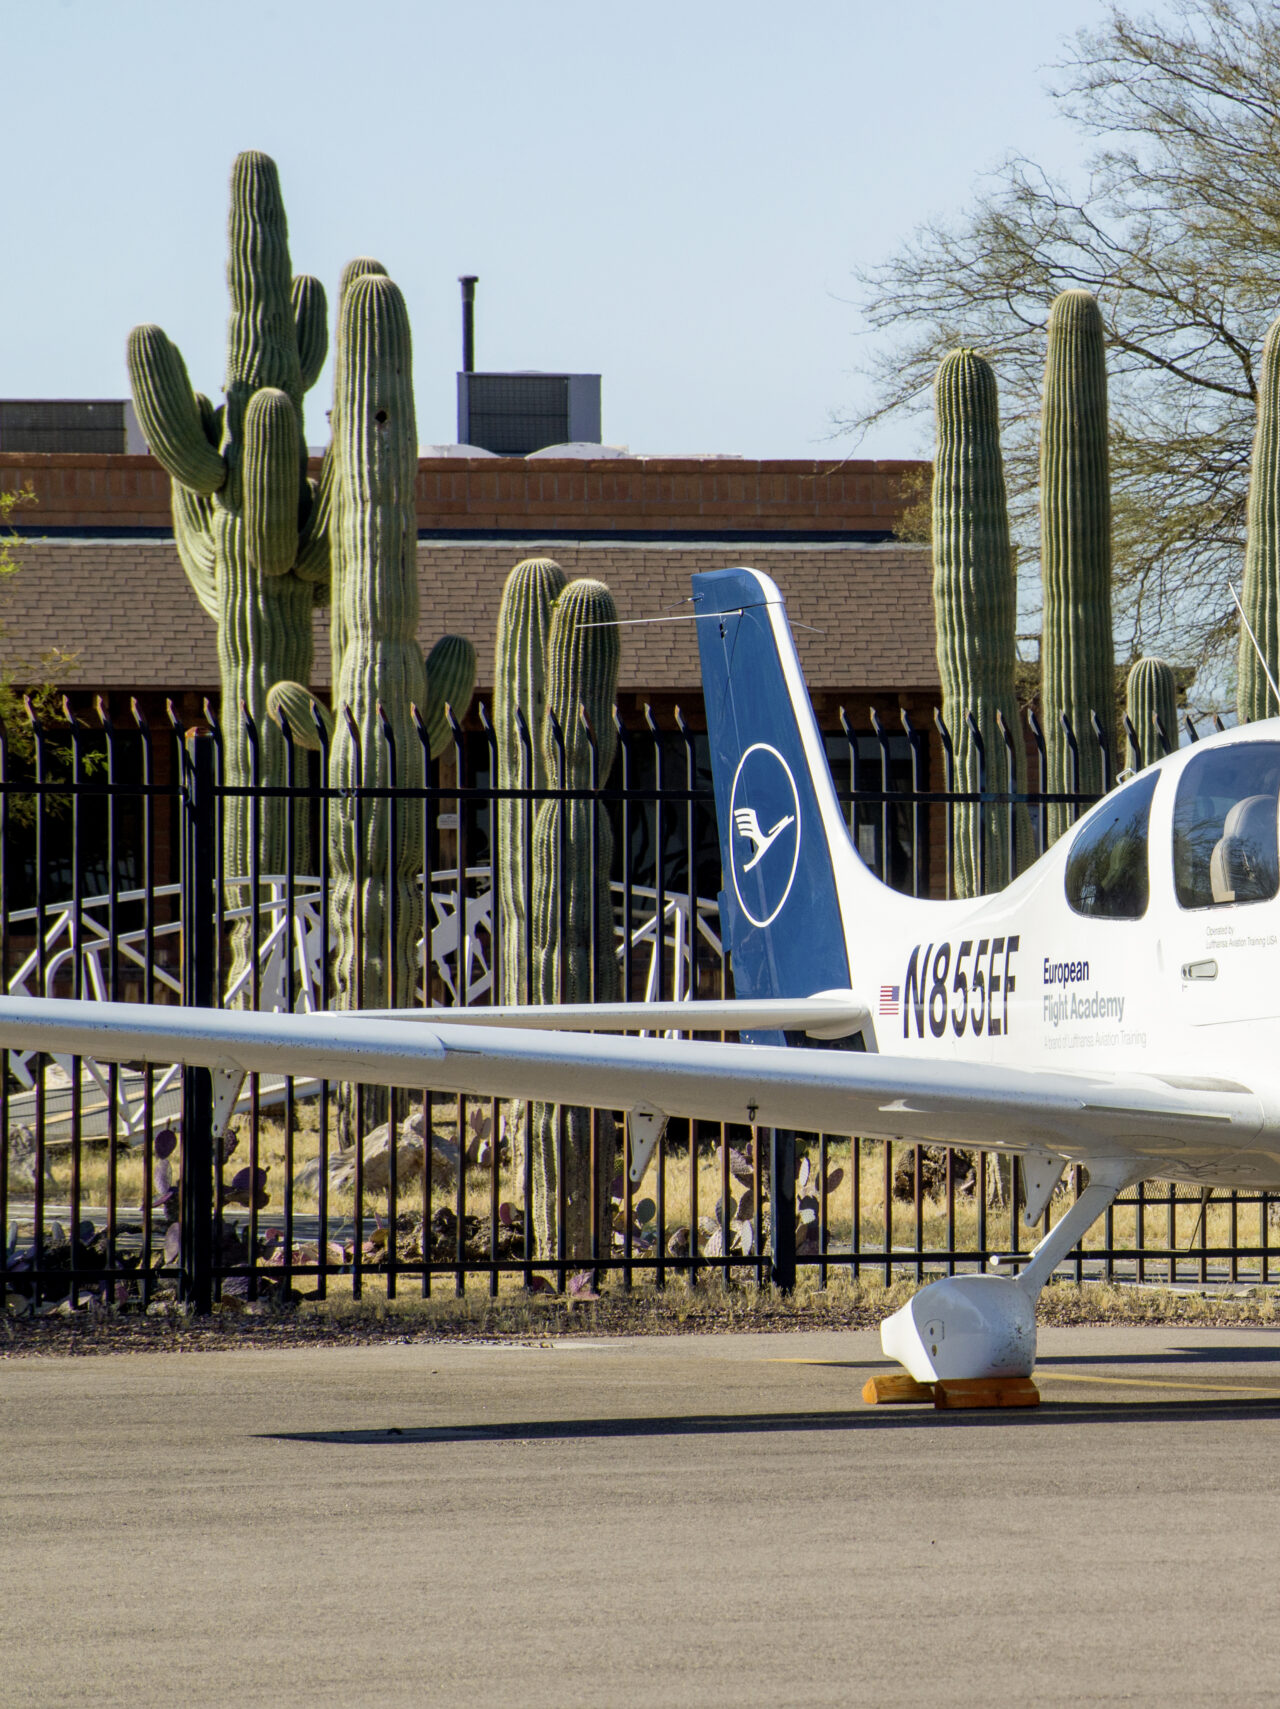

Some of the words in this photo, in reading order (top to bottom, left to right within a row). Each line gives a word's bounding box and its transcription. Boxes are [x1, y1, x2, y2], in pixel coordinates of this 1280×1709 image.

[904, 935, 1020, 1039] N855EF
[1043, 957, 1089, 989] European
[1043, 993, 1068, 1027] Flight
[1070, 991, 1125, 1023] Academy
